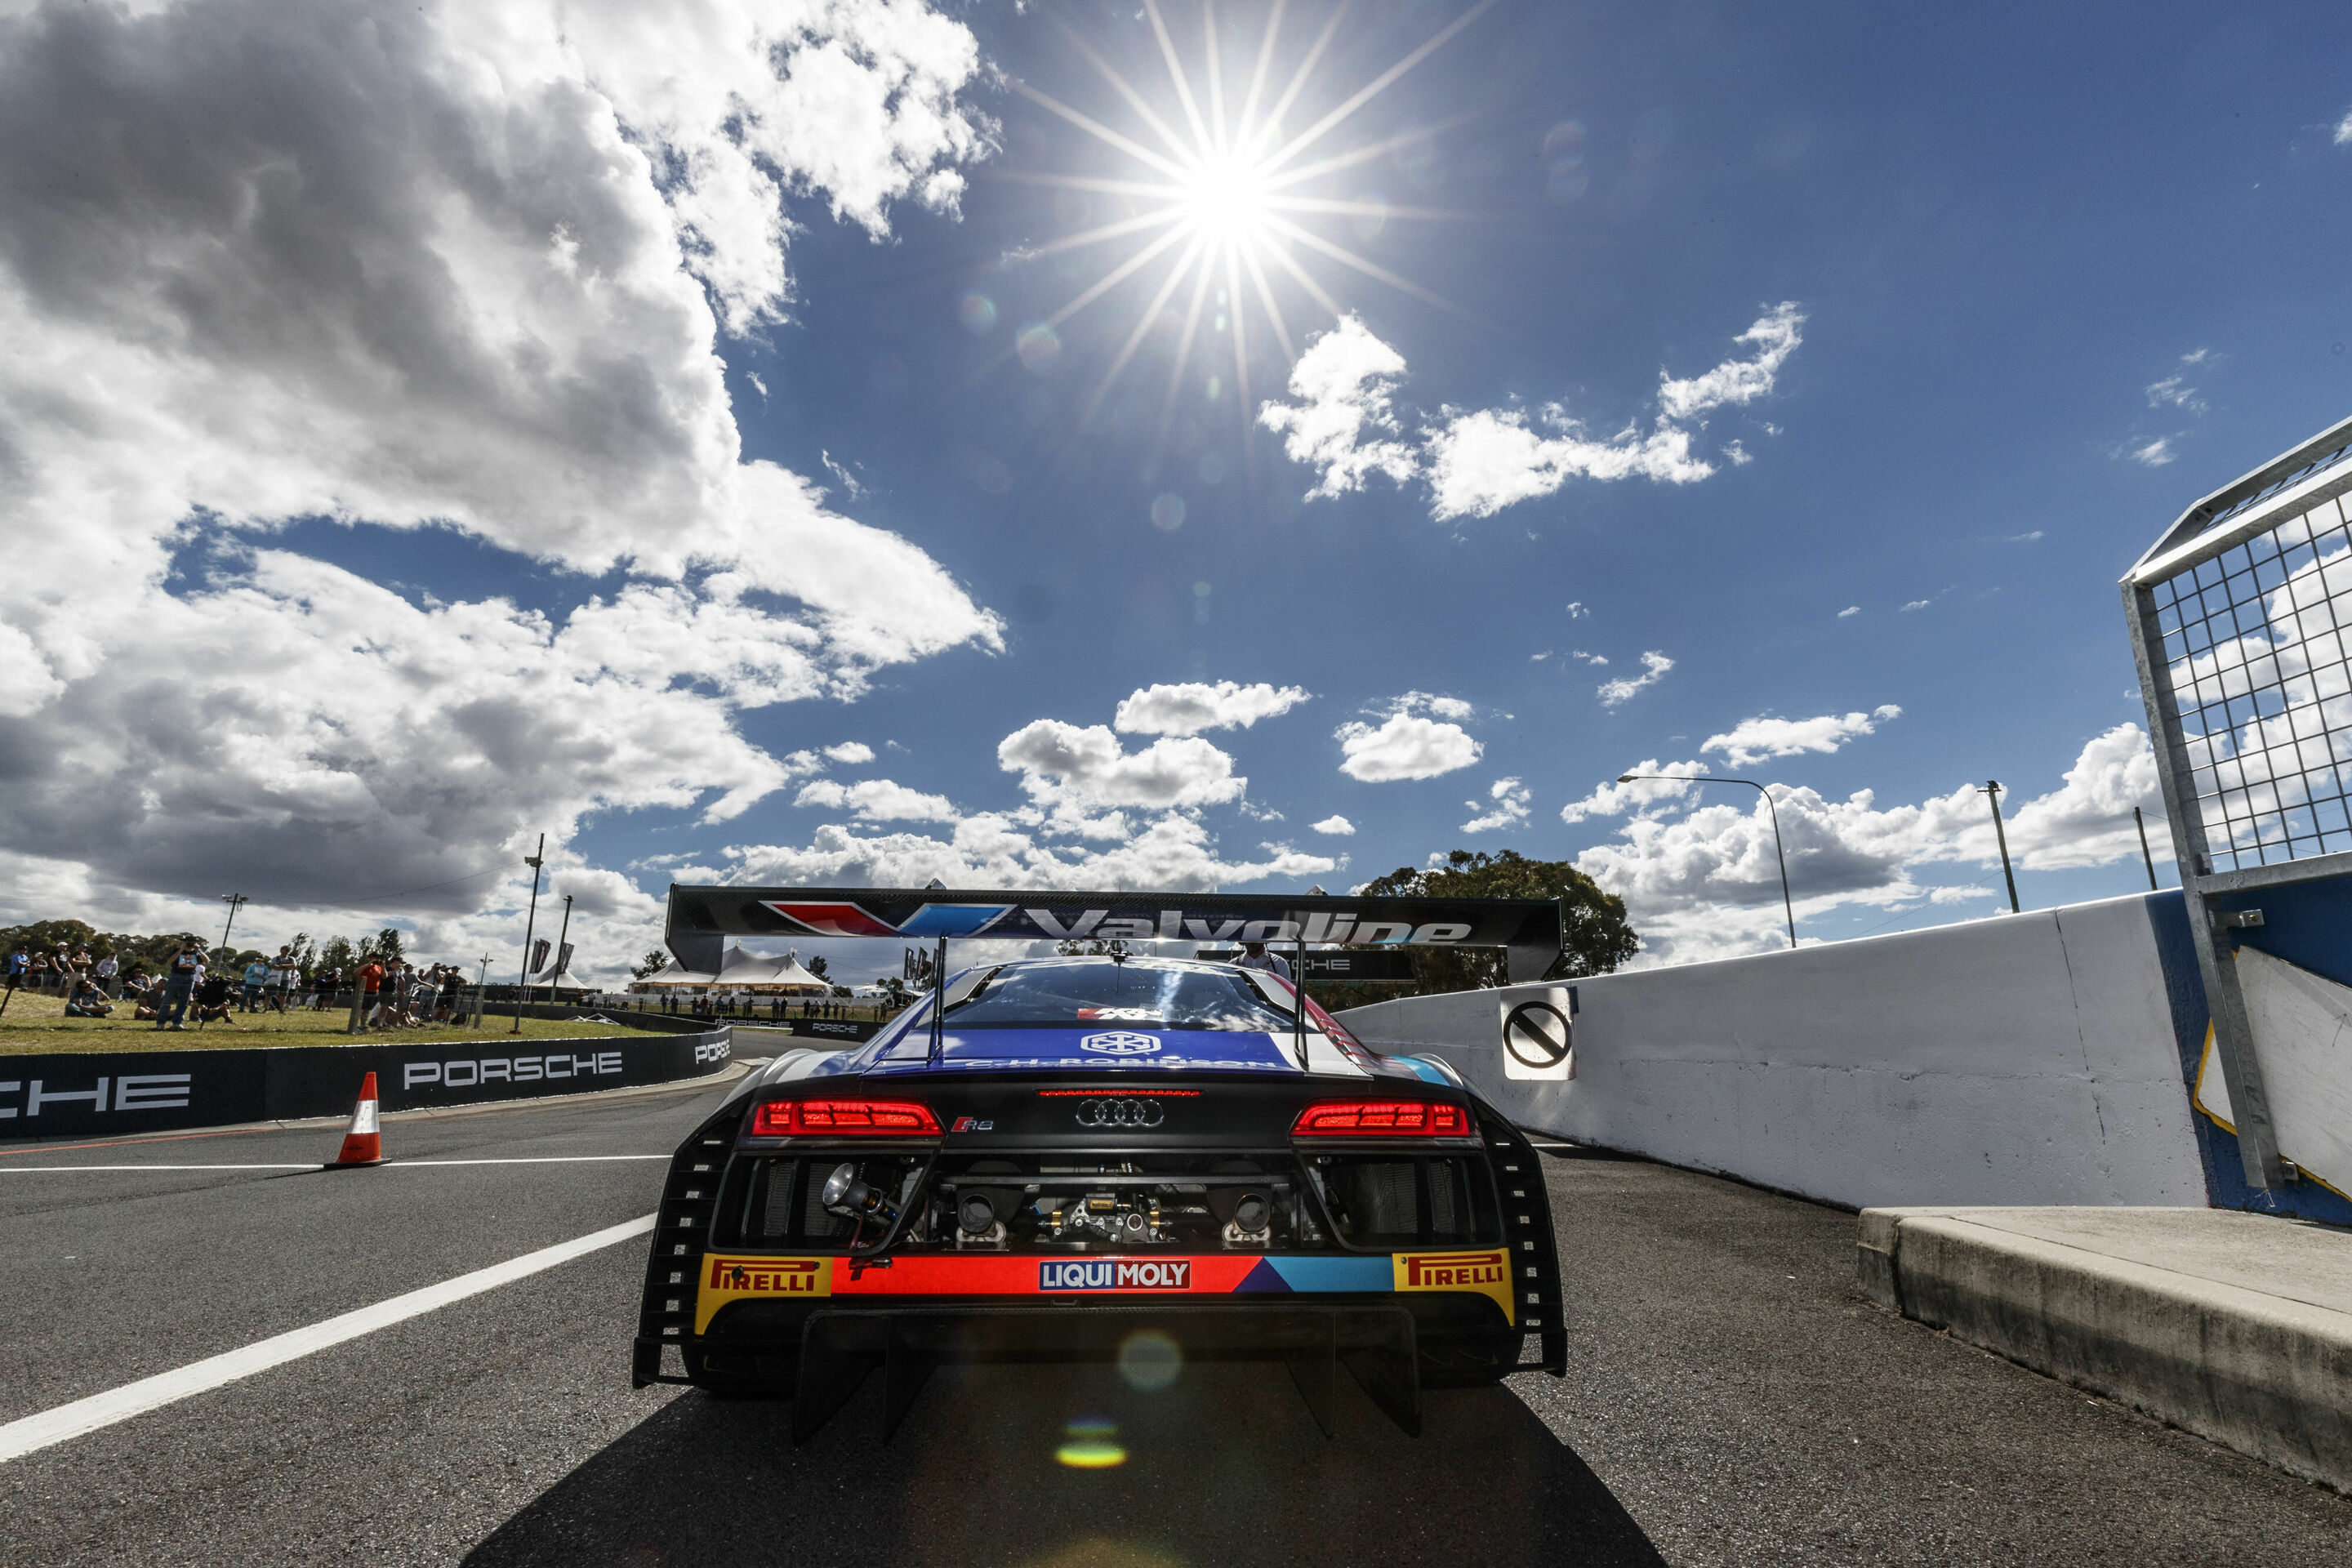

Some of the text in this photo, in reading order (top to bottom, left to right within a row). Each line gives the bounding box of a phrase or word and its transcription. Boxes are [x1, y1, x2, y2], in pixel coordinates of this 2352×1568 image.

[1024, 909, 1472, 944] Valvoline
[715, 1018, 791, 1027] PORSCHE
[813, 1022, 858, 1034] PORSCHE
[404, 1052, 622, 1089] PORSCHE
[1059, 1058, 1276, 1068] ROBINSON
[958, 1119, 994, 1131] R8
[710, 1258, 819, 1291] PIRELLI
[1043, 1263, 1188, 1288] LIQUI MOLY
[1408, 1253, 1503, 1286] PIRELLI
